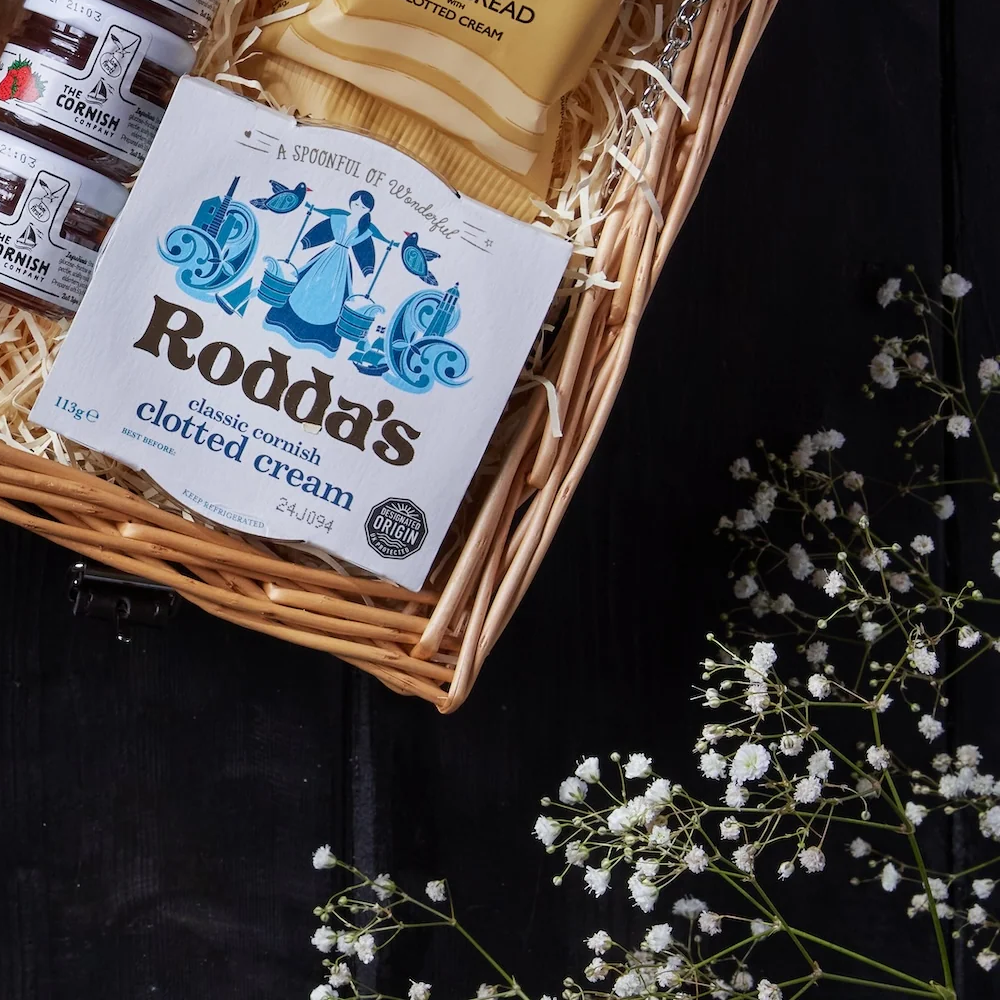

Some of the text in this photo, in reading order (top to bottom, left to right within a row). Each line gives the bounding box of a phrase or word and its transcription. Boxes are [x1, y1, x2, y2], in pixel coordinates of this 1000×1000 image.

[66, 0, 102, 22] 21:03
[458, 15, 504, 41] CREAM
[64, 84, 83, 99] THE
[56, 94, 121, 132] CORNISH
[74, 116, 115, 138] COMPANY
[276, 144, 459, 240] A SPOONFUL OF Wonderful
[3, 262, 45, 283] COMPANY
[133, 294, 422, 466] Rodda's
[121, 427, 176, 456] BEST BEFORE:
[188, 397, 322, 466] classic cornish
[136, 399, 355, 512] clotted cream
[182, 488, 265, 529] KEEP REFRIGERATED
[276, 497, 334, 534] 24J094
[380, 507, 421, 530] DESIGNATED
[373, 515, 419, 545] ORIGIN
[375, 541, 409, 556] PROTECTED
